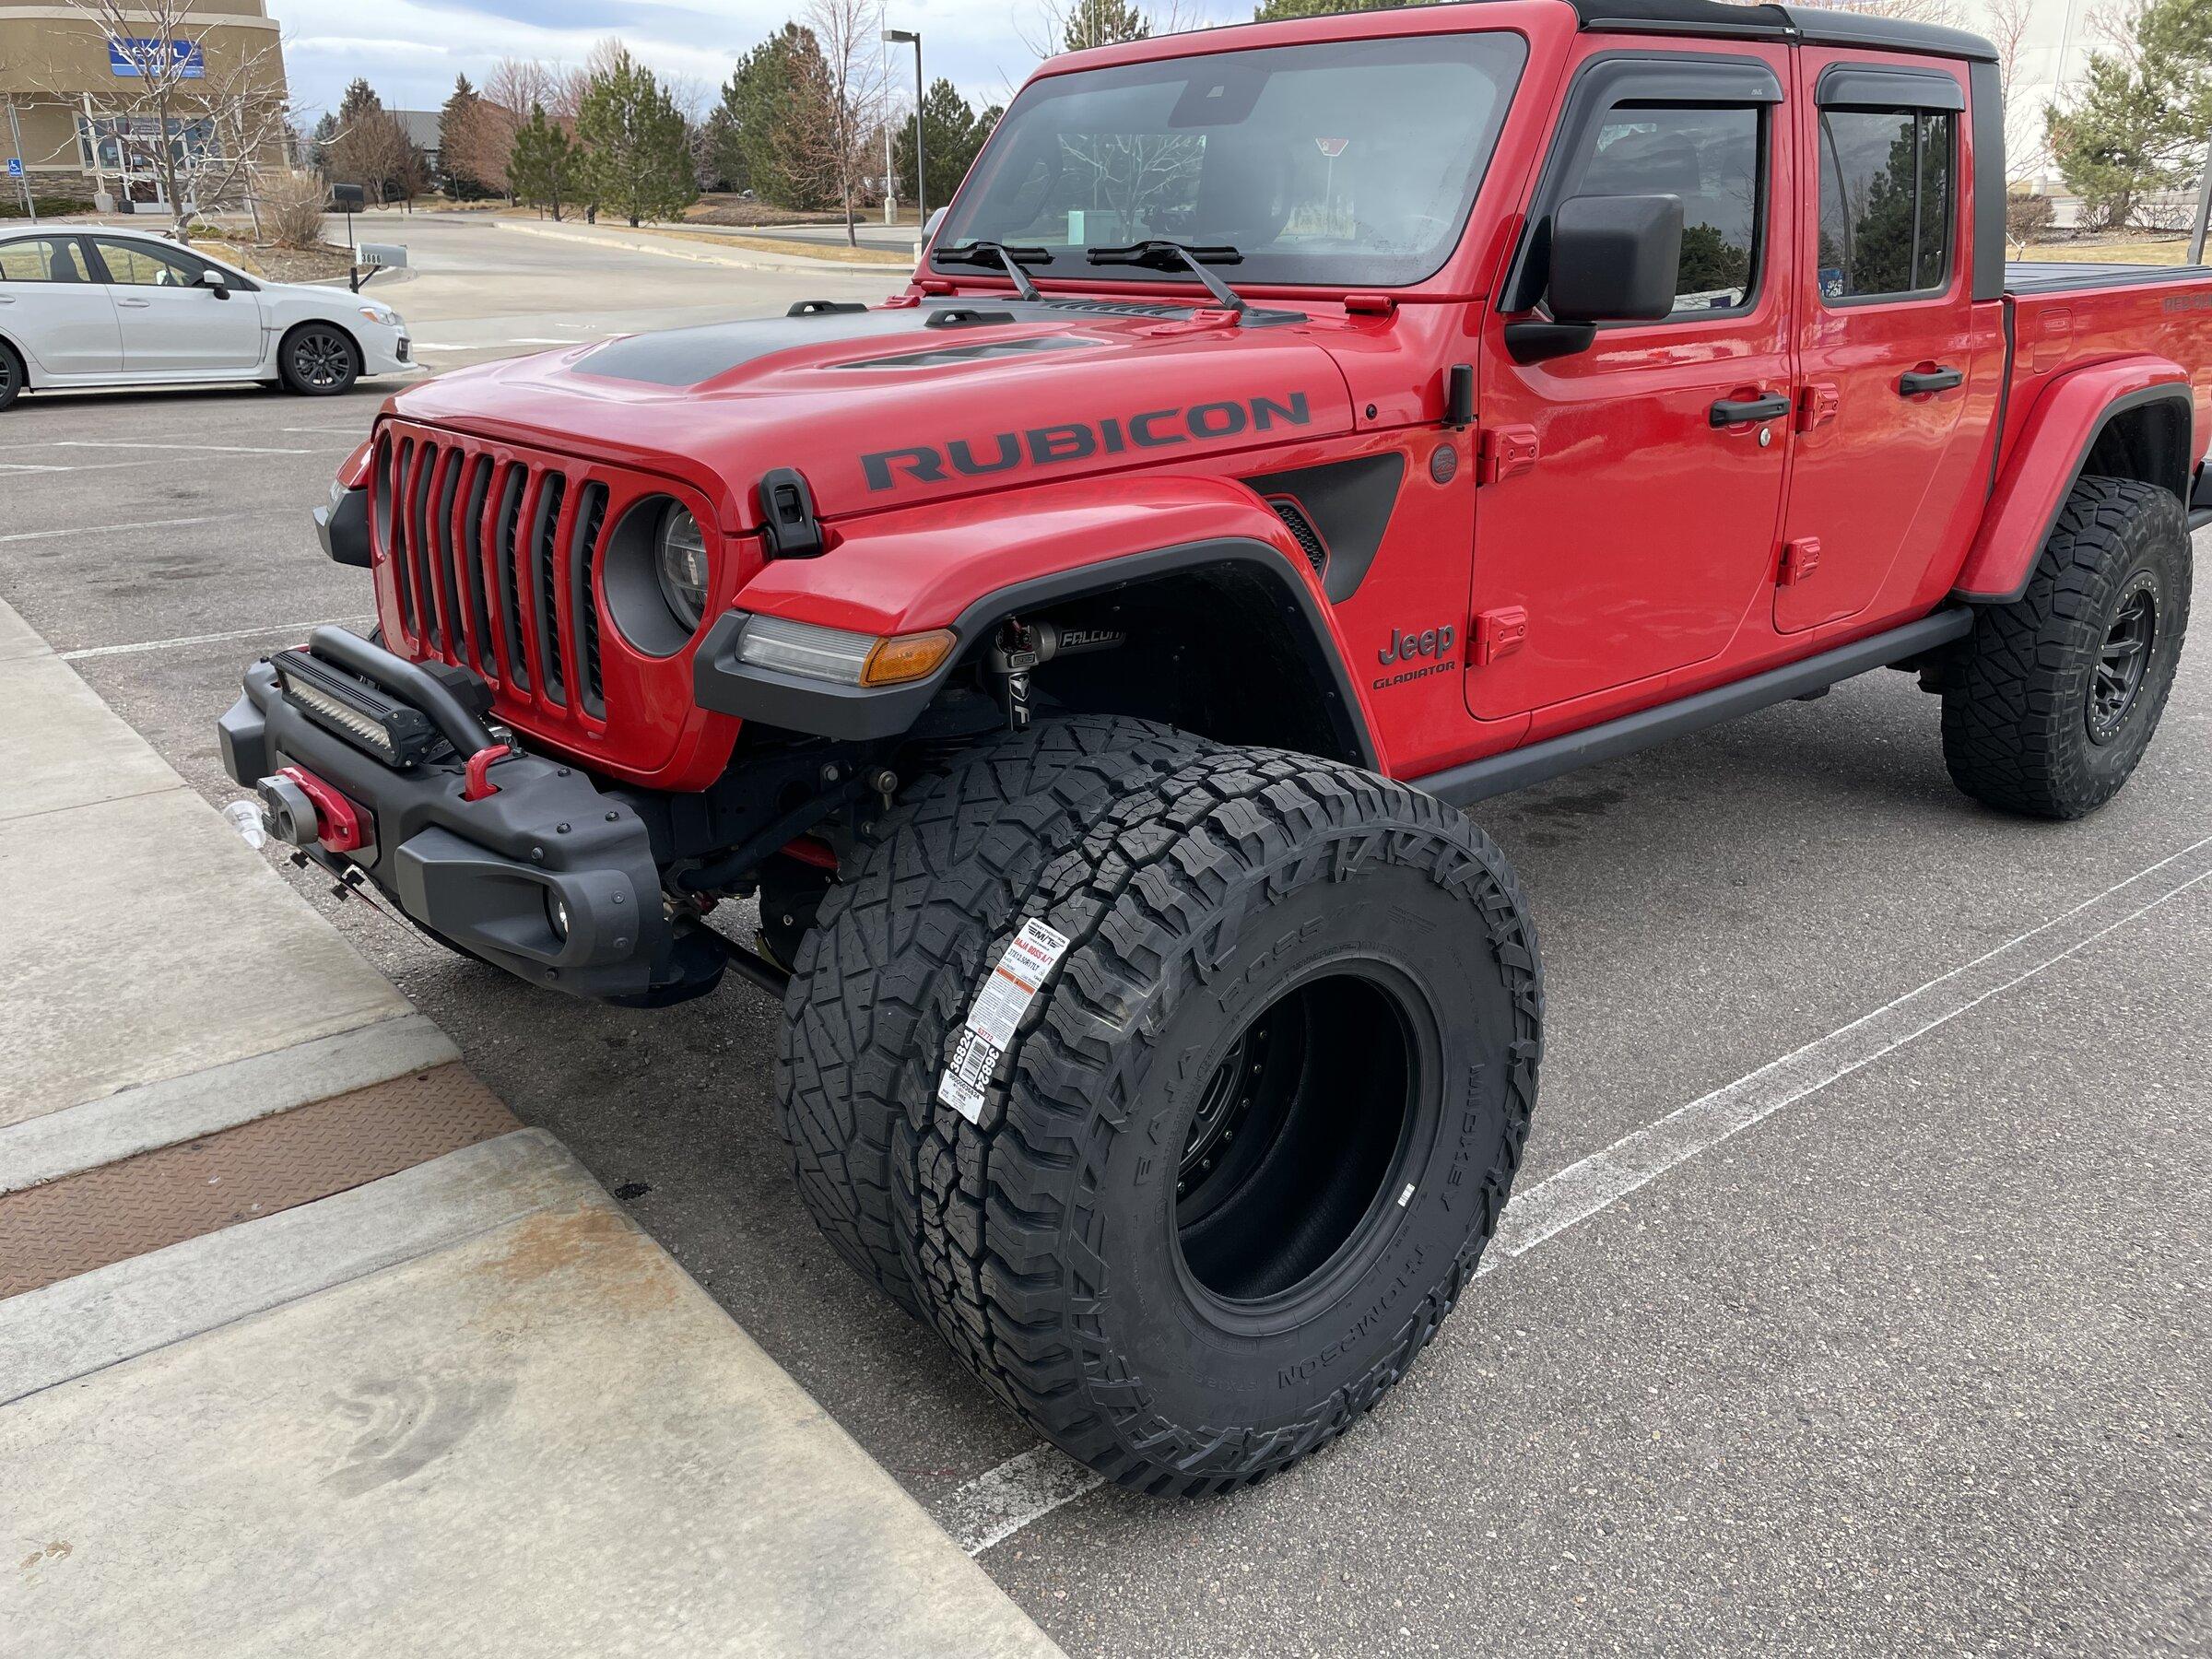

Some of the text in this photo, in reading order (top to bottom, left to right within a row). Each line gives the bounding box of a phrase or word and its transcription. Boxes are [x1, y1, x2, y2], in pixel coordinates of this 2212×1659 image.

[361, 253, 382, 264] 3686
[857, 391, 1312, 492] RUBICON
[1378, 624, 1455, 665] Jeep
[1372, 661, 1455, 690] GLADIATOR
[1014, 936, 1030, 951] BAJA
[1027, 946, 1042, 960] BOSS
[1041, 954, 1054, 966] A/T
[949, 1030, 974, 1074] 36824
[975, 1047, 1000, 1093] 36824
[1275, 1244, 1426, 1390] THOMPSON
